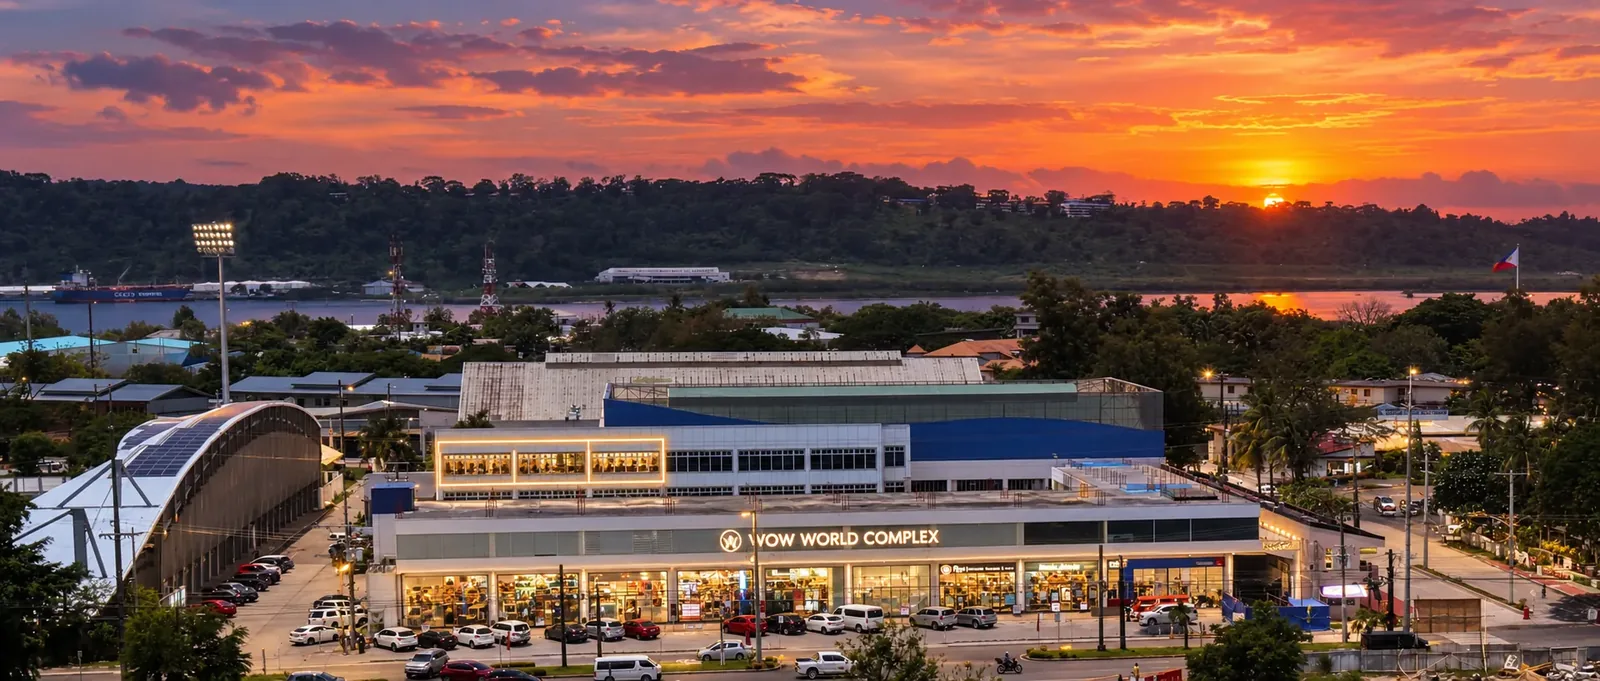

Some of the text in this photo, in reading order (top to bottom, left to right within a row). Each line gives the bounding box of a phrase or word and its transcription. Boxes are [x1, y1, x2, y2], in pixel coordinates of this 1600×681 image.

[748, 529, 939, 547] WOW WORLD COMPLEX
